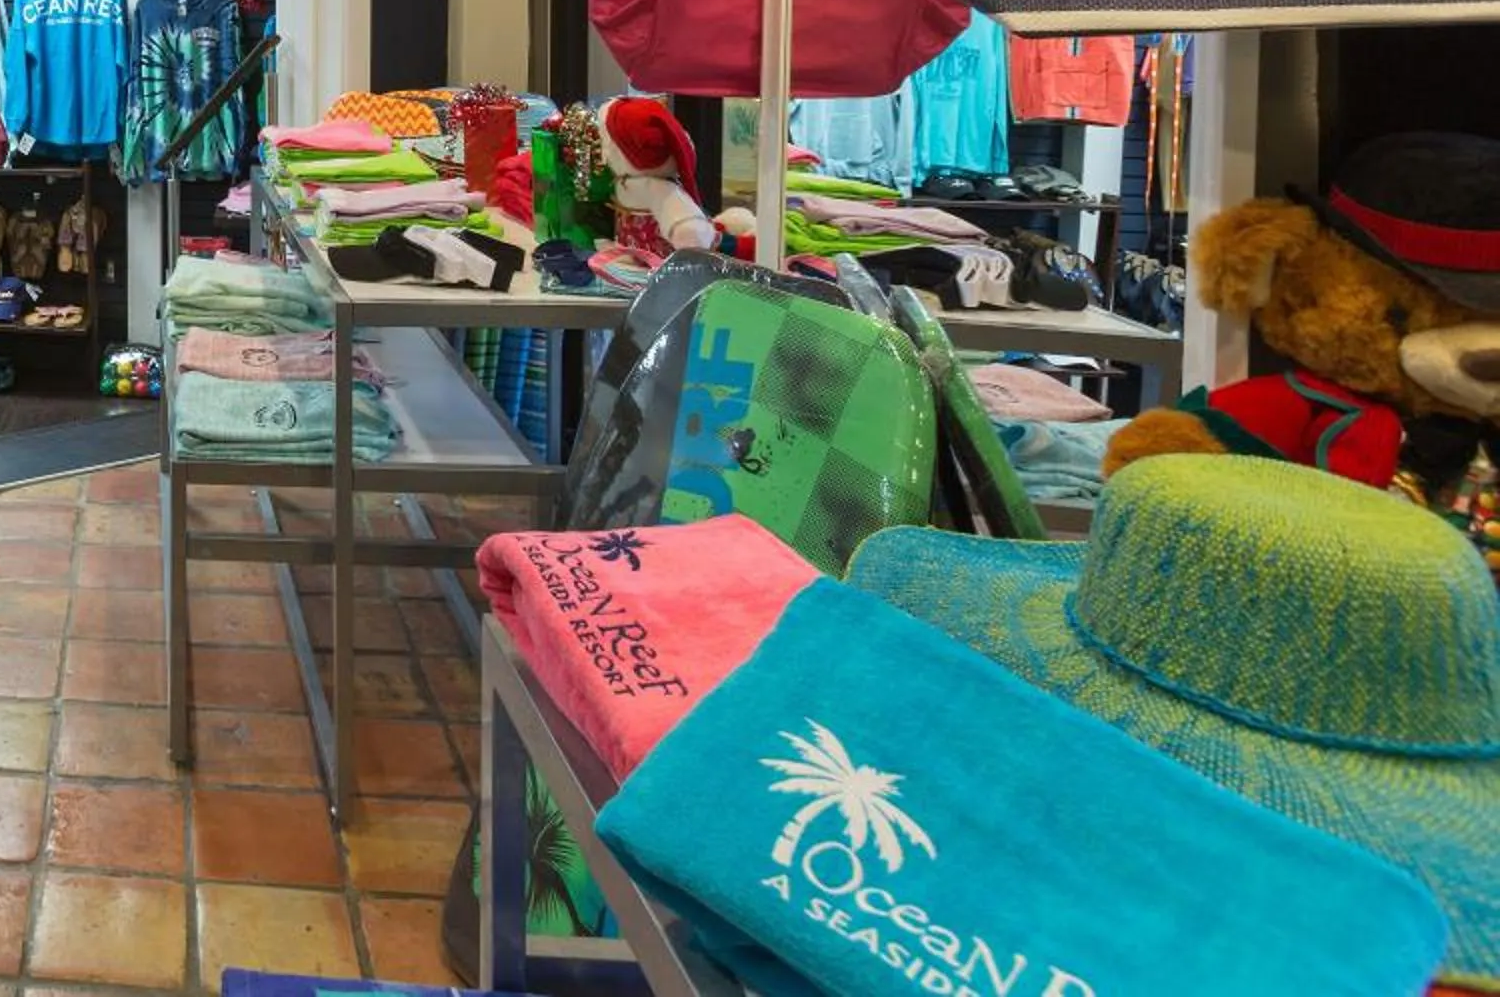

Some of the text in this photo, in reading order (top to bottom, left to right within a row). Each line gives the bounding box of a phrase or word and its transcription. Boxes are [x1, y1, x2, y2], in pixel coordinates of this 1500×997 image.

[522, 543, 635, 697] SEASIDE RESORT
[760, 874, 790, 902] A
